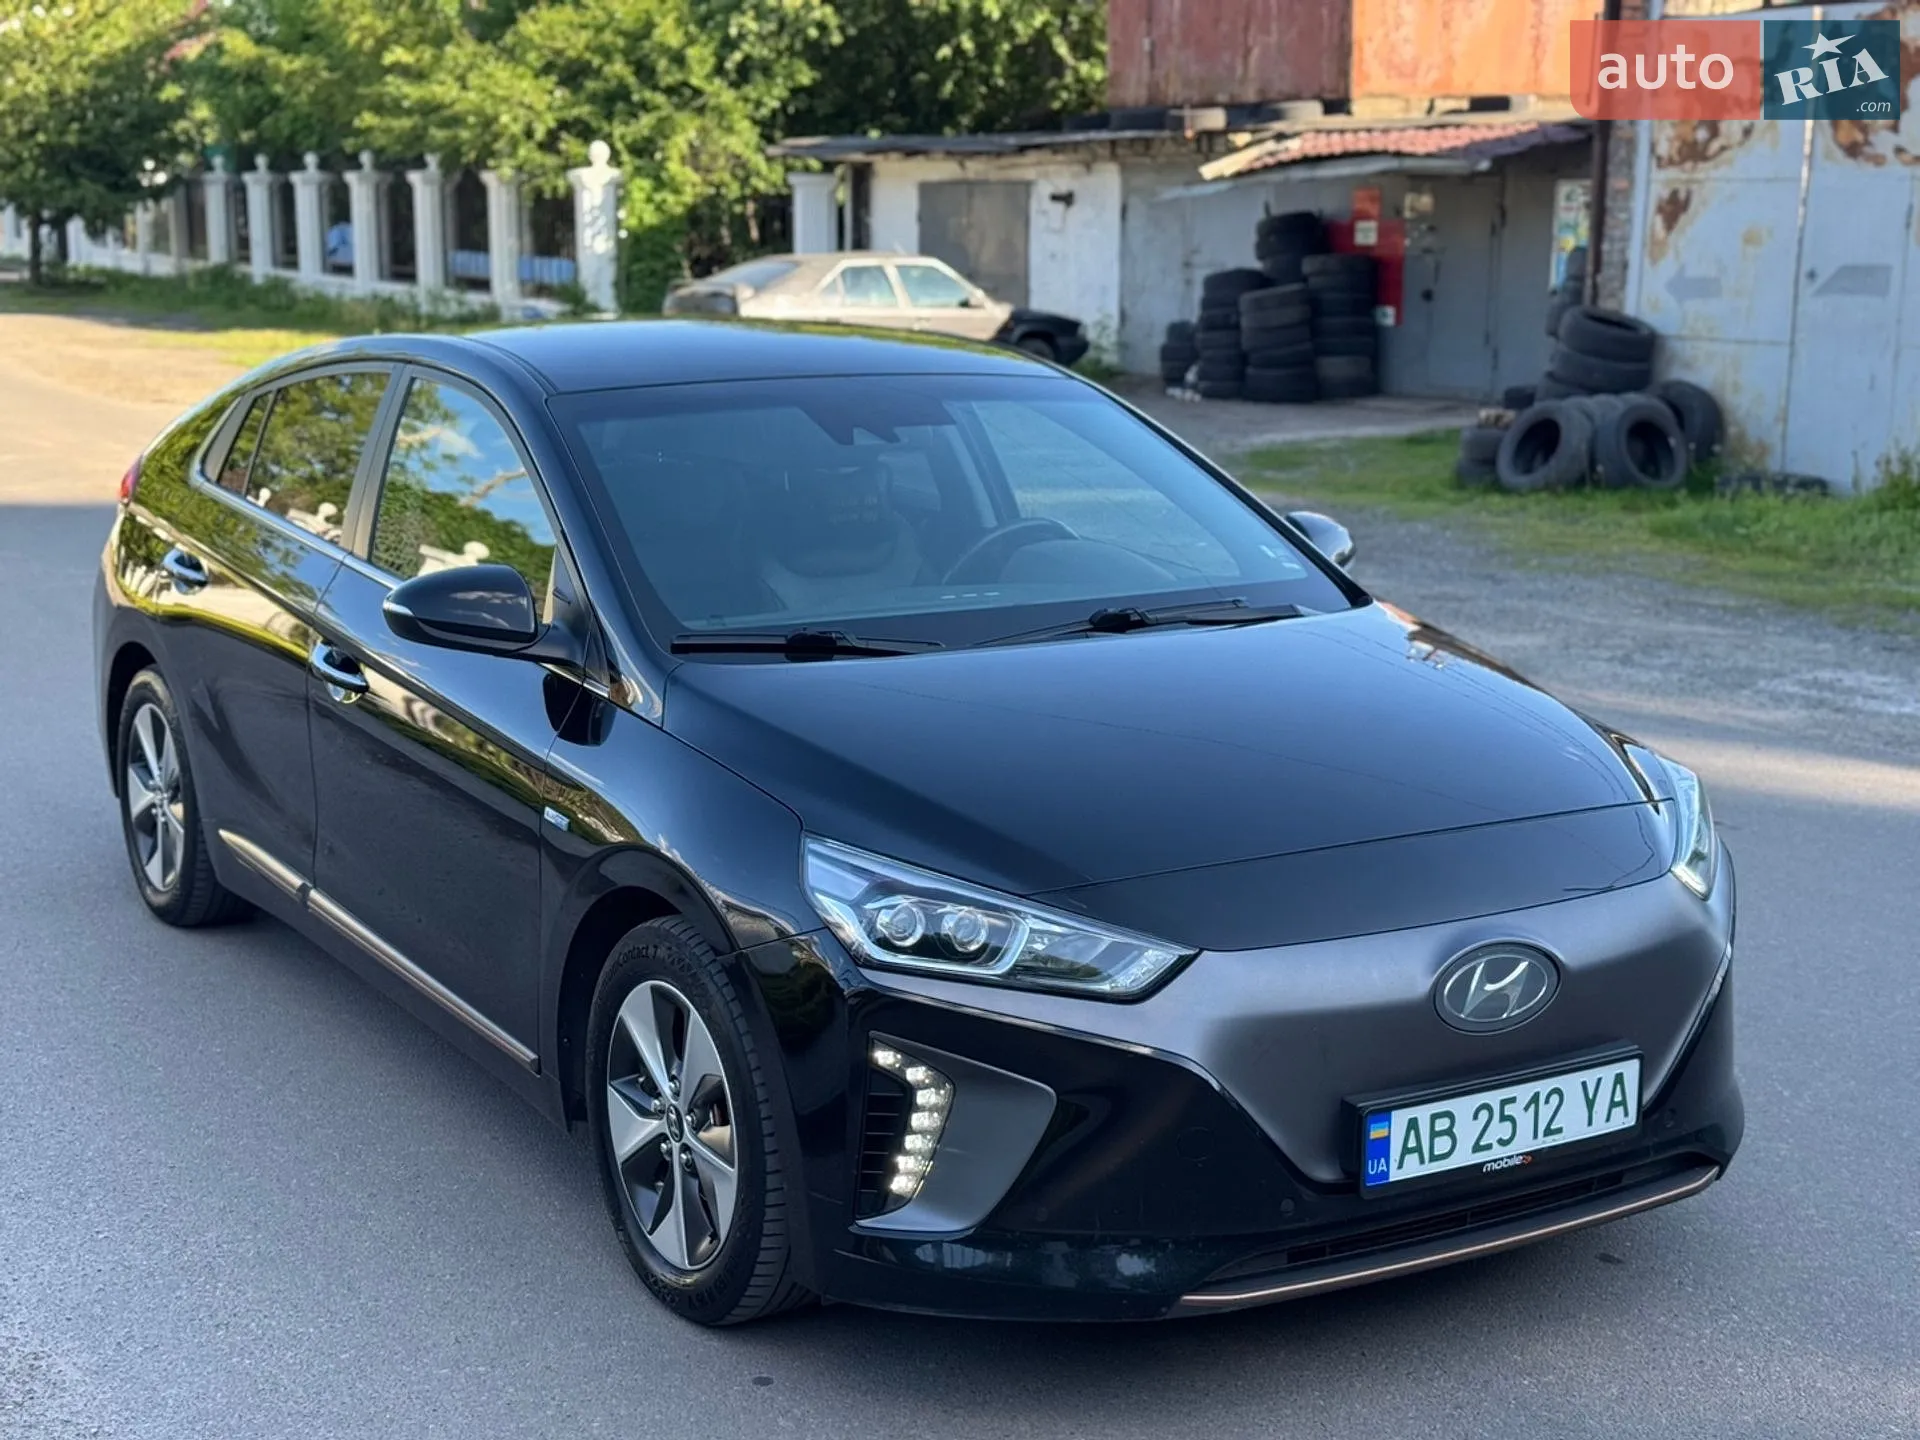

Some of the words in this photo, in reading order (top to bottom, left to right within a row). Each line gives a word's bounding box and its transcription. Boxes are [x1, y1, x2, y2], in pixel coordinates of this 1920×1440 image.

[1397, 1110, 1458, 1170] AB
[1471, 1086, 1564, 1154] 2512
[1581, 1071, 1630, 1128] YA
[1367, 1157, 1388, 1175] UA
